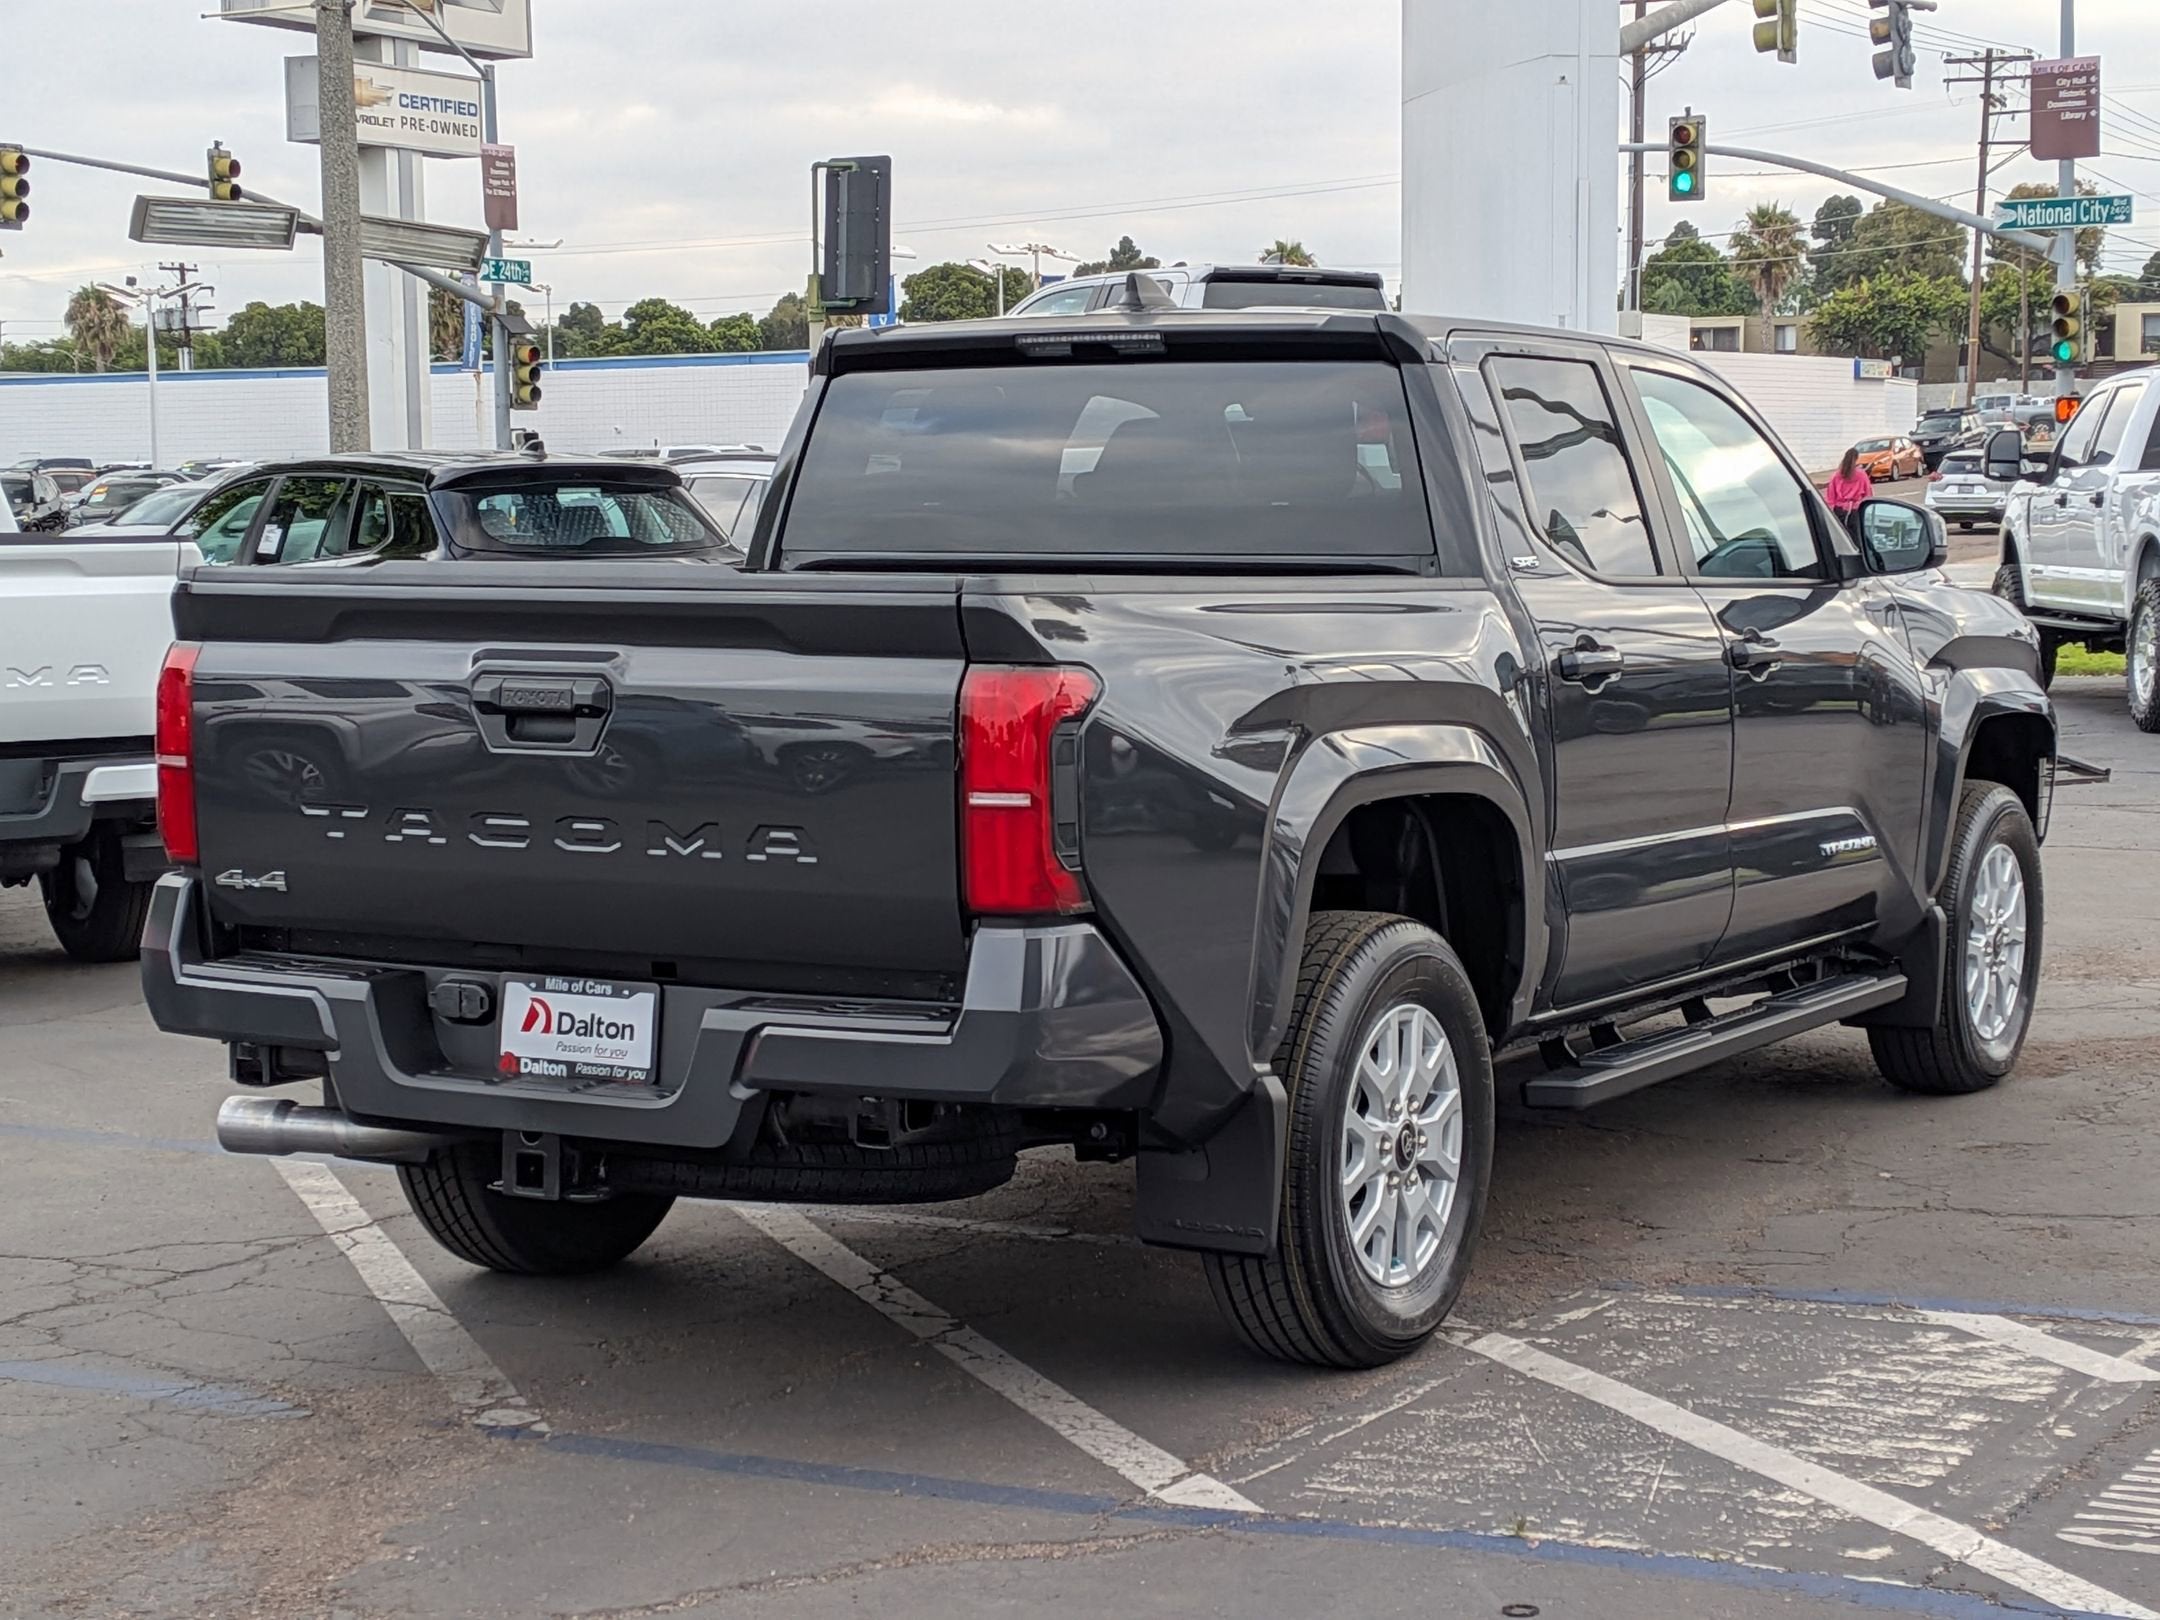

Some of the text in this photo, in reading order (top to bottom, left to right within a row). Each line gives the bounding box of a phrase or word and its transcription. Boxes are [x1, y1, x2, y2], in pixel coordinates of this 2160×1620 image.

[2056, 75, 2087, 88] City Hall
[2058, 89, 2087, 98] Historic
[398, 93, 478, 117] CERTIFIED
[355, 114, 396, 129] VROLET
[2060, 111, 2087, 121] Library
[400, 115, 478, 138] PRE-OWNED
[2017, 199, 2110, 226] National City
[489, 260, 498, 280] E
[499, 260, 522, 281] 24th
[504, 689, 569, 707] TOYOTA
[300, 802, 818, 863] TACOMA
[545, 977, 613, 995] Mile of Cars
[556, 1011, 635, 1041] Dalton
[555, 1041, 628, 1058] Passion for you
[520, 1058, 567, 1077] Dalton
[575, 1063, 647, 1080] Passion for you
